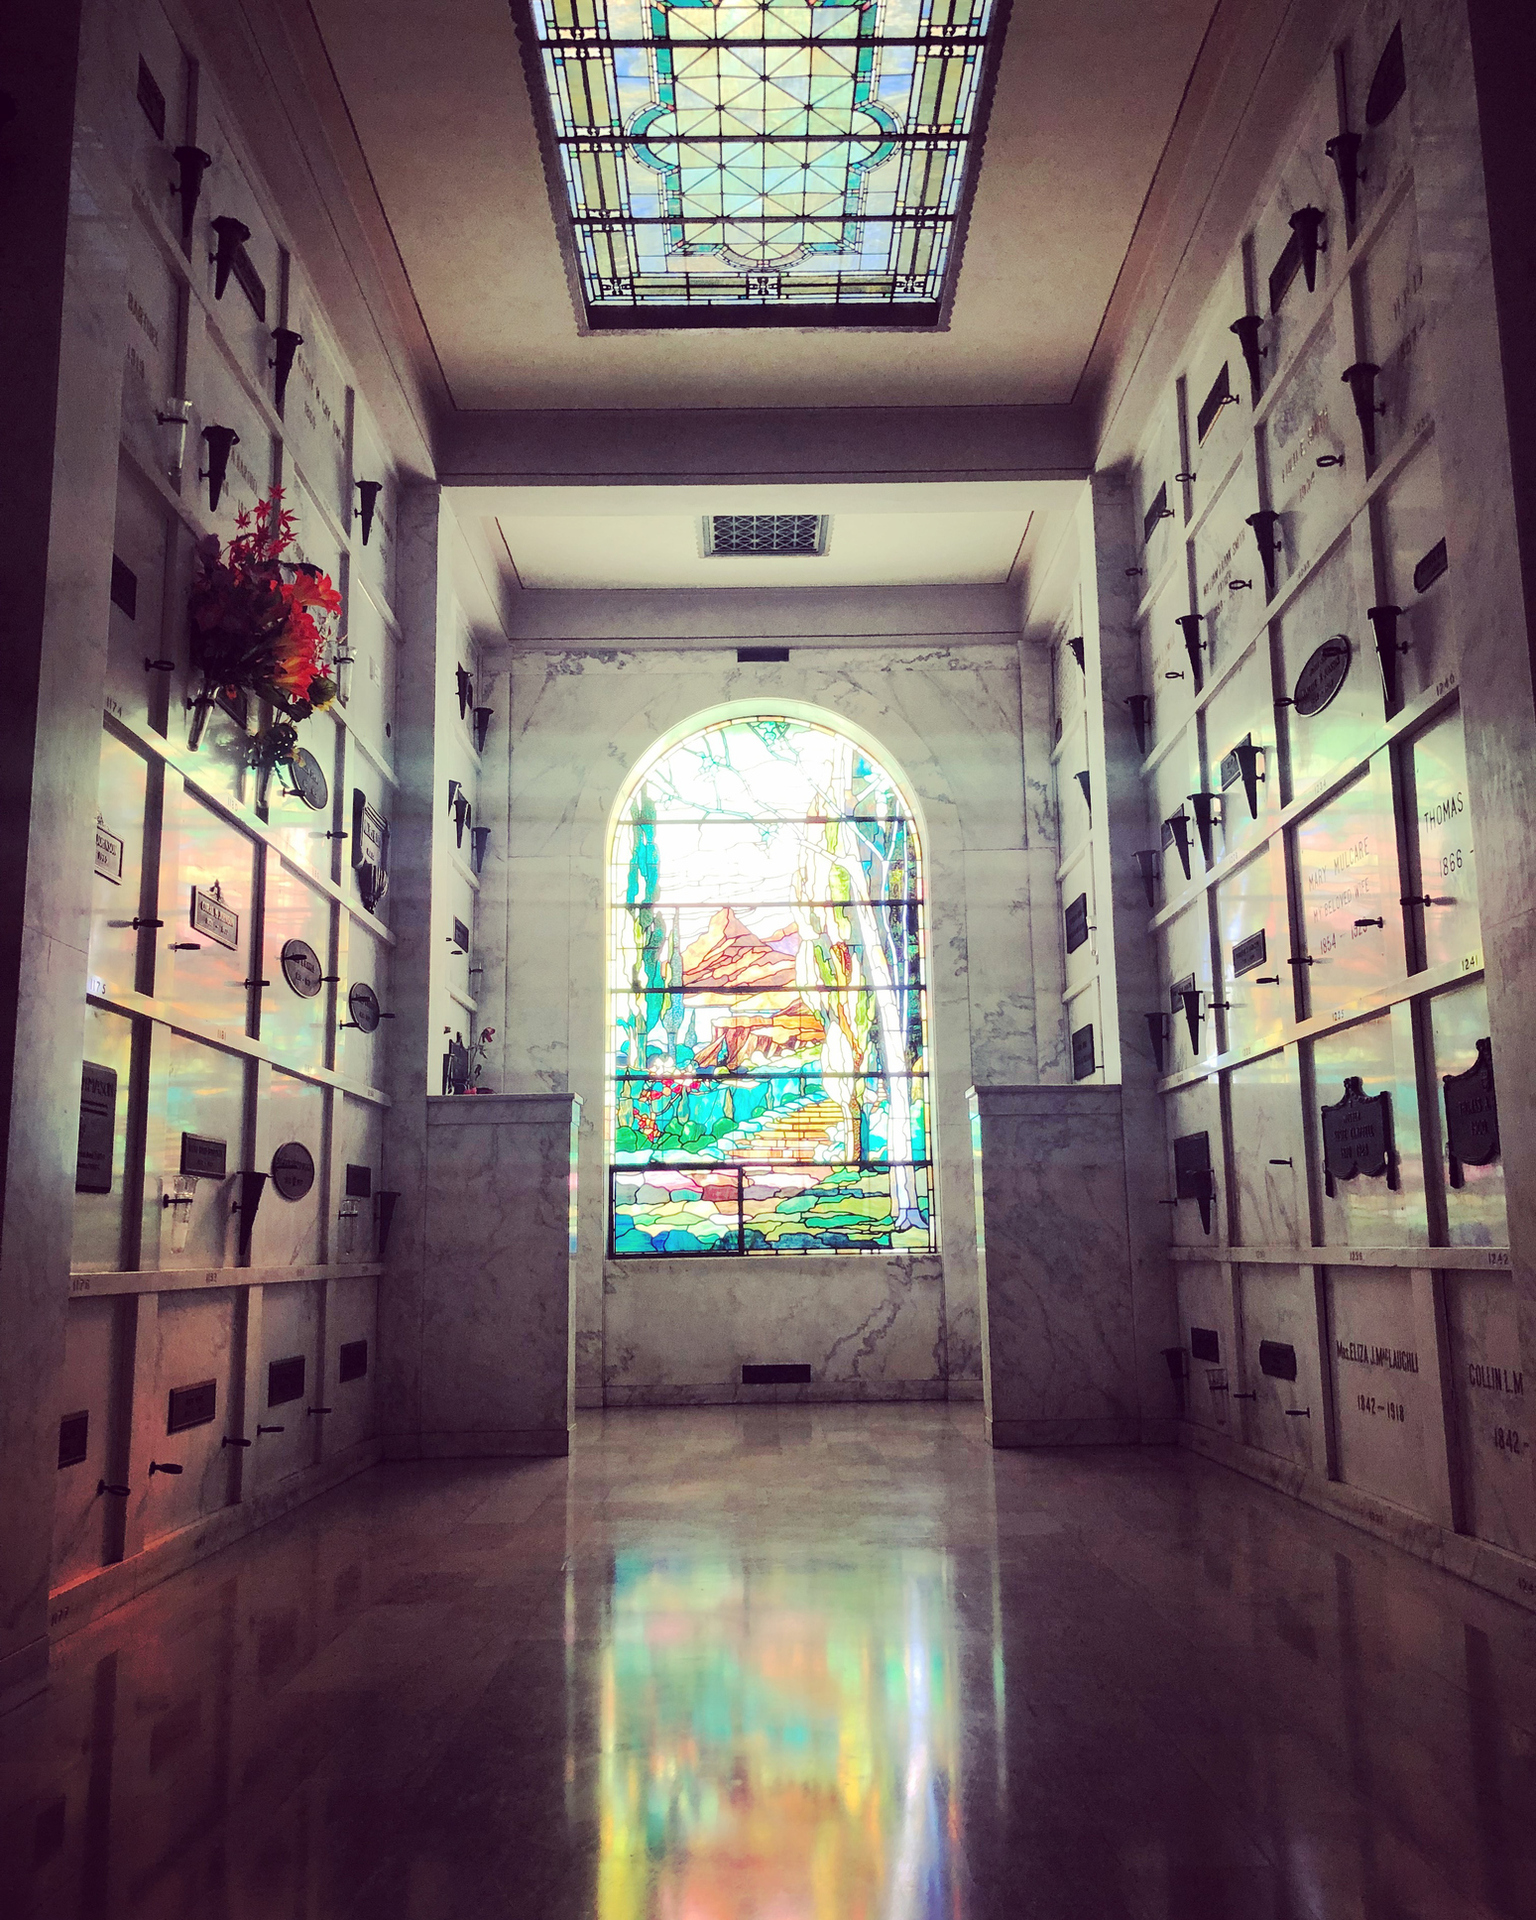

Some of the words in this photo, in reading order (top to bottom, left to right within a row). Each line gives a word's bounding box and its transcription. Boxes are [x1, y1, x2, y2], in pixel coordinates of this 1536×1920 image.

[105, 697, 122, 717] 1174
[1423, 791, 1464, 834] THOMAS
[1308, 864, 1327, 892] MARY
[1333, 836, 1371, 876] MULCARE
[1324, 888, 1353, 918] BELOVED
[1461, 954, 1479, 972] 1241
[89, 978, 107, 996] 1175
[1488, 1252, 1509, 1266] 1242
